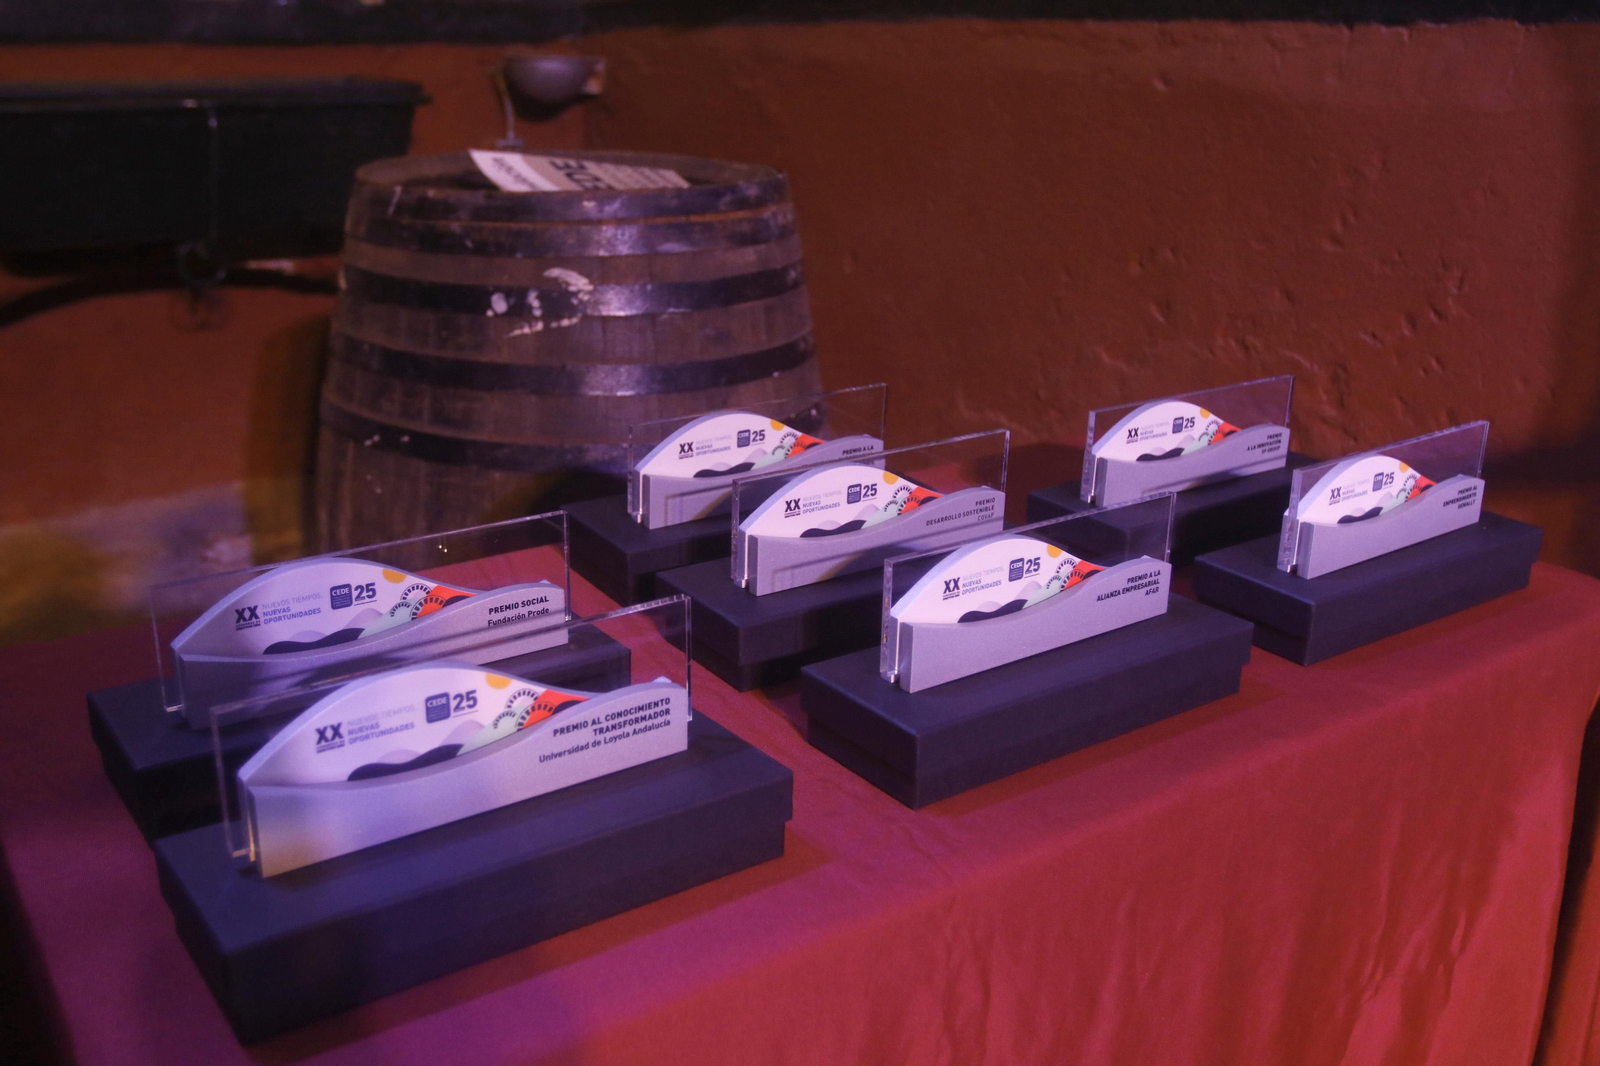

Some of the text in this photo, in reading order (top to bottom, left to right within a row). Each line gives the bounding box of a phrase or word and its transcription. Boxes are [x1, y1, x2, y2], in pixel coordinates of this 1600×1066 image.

[1184, 417, 1195, 430] 25
[752, 430, 766, 443] 25
[1126, 427, 1140, 439] XX
[679, 441, 694, 455] XX
[842, 447, 862, 455] PREMIO
[1384, 472, 1395, 486] 25
[862, 483, 877, 498] 25
[1330, 486, 1342, 500] XX
[784, 498, 801, 513] XX
[802, 502, 841, 514] OPORTUNIDADES
[803, 500, 821, 508] NUEVAS
[975, 497, 996, 506] PREMIO
[926, 505, 994, 526] DESARROLLO SOSTENIBLE
[978, 512, 994, 521] COVAP
[1025, 557, 1040, 574] 25
[943, 577, 960, 594] XX
[962, 579, 982, 588] NUEVAS
[1127, 573, 1148, 584] PREMIO
[332, 587, 350, 596] CEDE
[354, 582, 377, 601] 25
[962, 580, 1002, 595] OPORTUNIDADES
[1096, 578, 1160, 602] ALIANZA EMPRESARIAL
[1145, 587, 1159, 596] AFAR
[262, 599, 290, 610] NUEVOS
[263, 606, 291, 617] NUEVAS
[488, 595, 550, 615] PREMIO SOCIAL
[234, 605, 260, 624] XX
[264, 607, 322, 625] OPORTUNIDADES
[488, 607, 550, 627] Fundación Prode
[427, 698, 448, 708] CEDE
[452, 690, 478, 713] 25
[553, 698, 671, 737] PREMIO AL CONOCIMIENTO
[592, 708, 670, 736] TRANSFORMADOR
[315, 722, 344, 745] XX
[348, 723, 380, 736] NUEVAS
[348, 722, 415, 745] OPORTUNIDADES
[539, 719, 671, 763] Universidad de Loyola Andalucía
